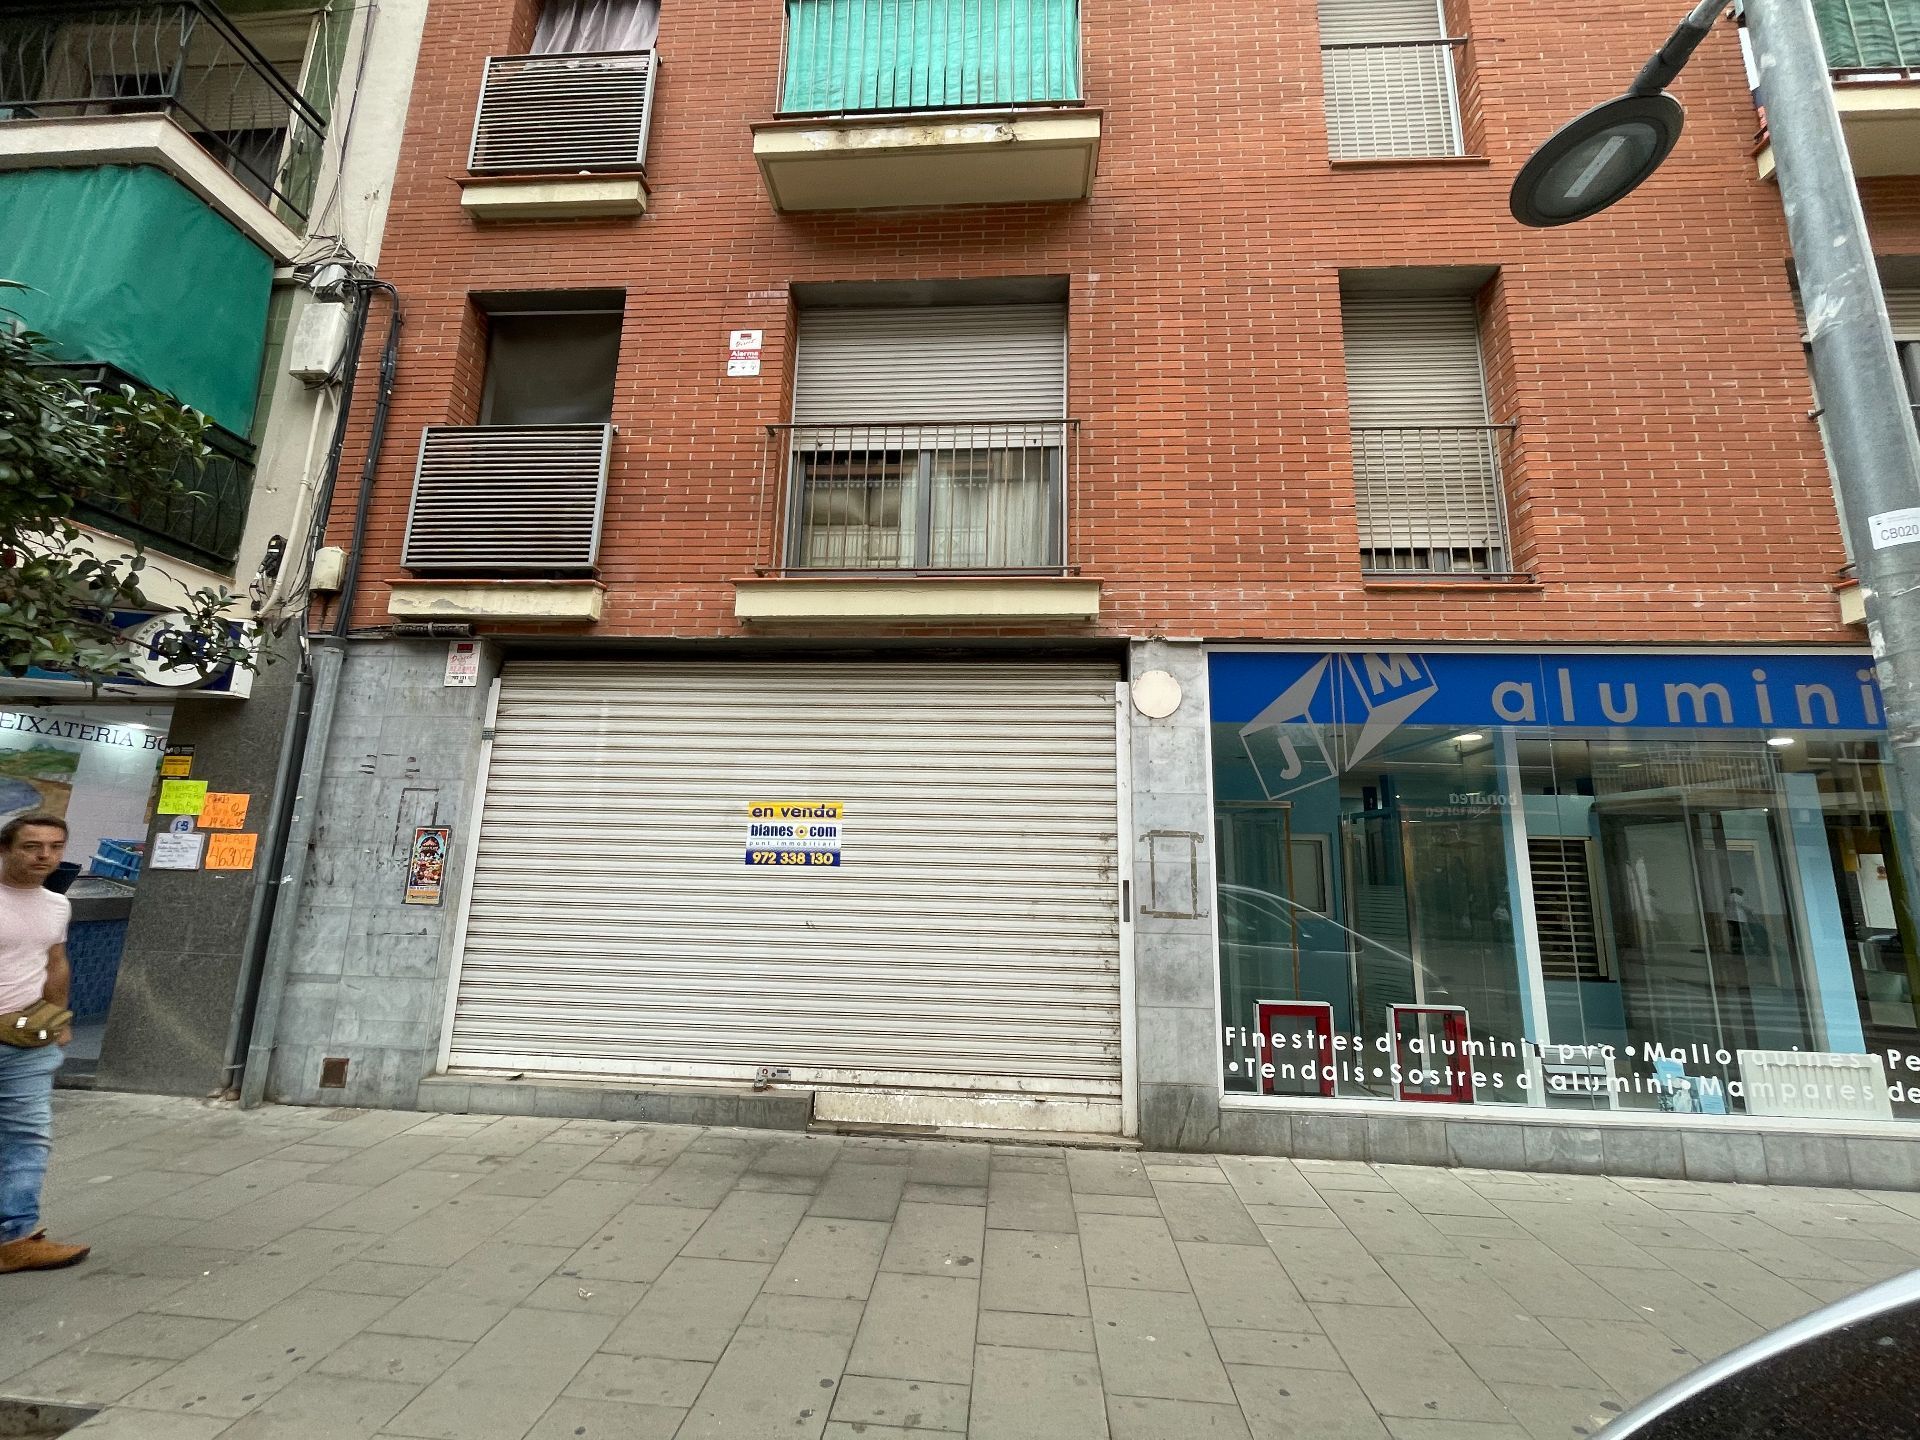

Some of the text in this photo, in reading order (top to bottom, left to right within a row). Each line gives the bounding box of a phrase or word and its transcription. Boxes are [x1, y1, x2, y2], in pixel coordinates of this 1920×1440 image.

[0, 711, 134, 747] EIXATERIA
[1277, 735, 1302, 780] J
[752, 804, 837, 818] en venda
[752, 852, 834, 865] 972 338 130
[1225, 1026, 1364, 1051] Finestres
[1375, 1032, 1527, 1058] d'alumini
[1643, 1041, 1861, 1071] Mallorquines
[1245, 1057, 1365, 1082] Tendals
[1390, 1063, 1504, 1089] Sostres
[1699, 1075, 1875, 1104] Mampares
